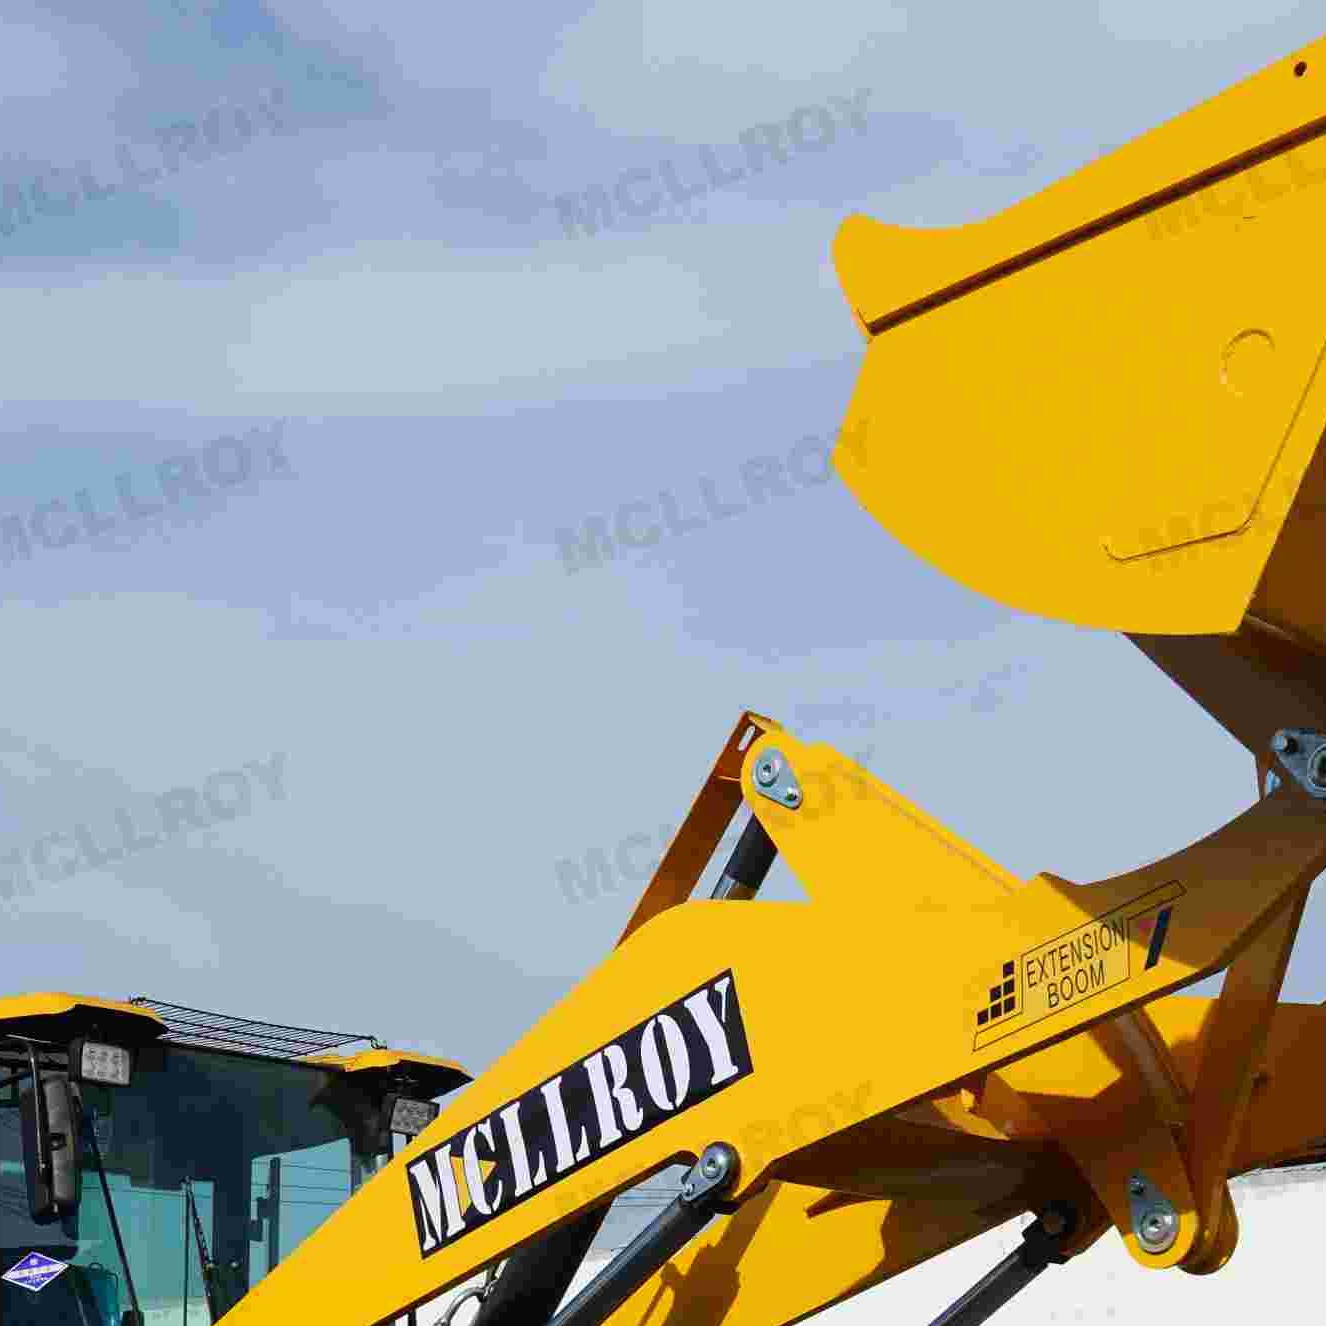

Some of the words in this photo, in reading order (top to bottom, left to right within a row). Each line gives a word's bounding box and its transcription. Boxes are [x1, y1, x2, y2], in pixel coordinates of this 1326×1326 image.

[1026, 914, 1126, 989] EXTENSION
[1047, 958, 1106, 1009] BOOM
[408, 976, 739, 1253] MCLLROY
